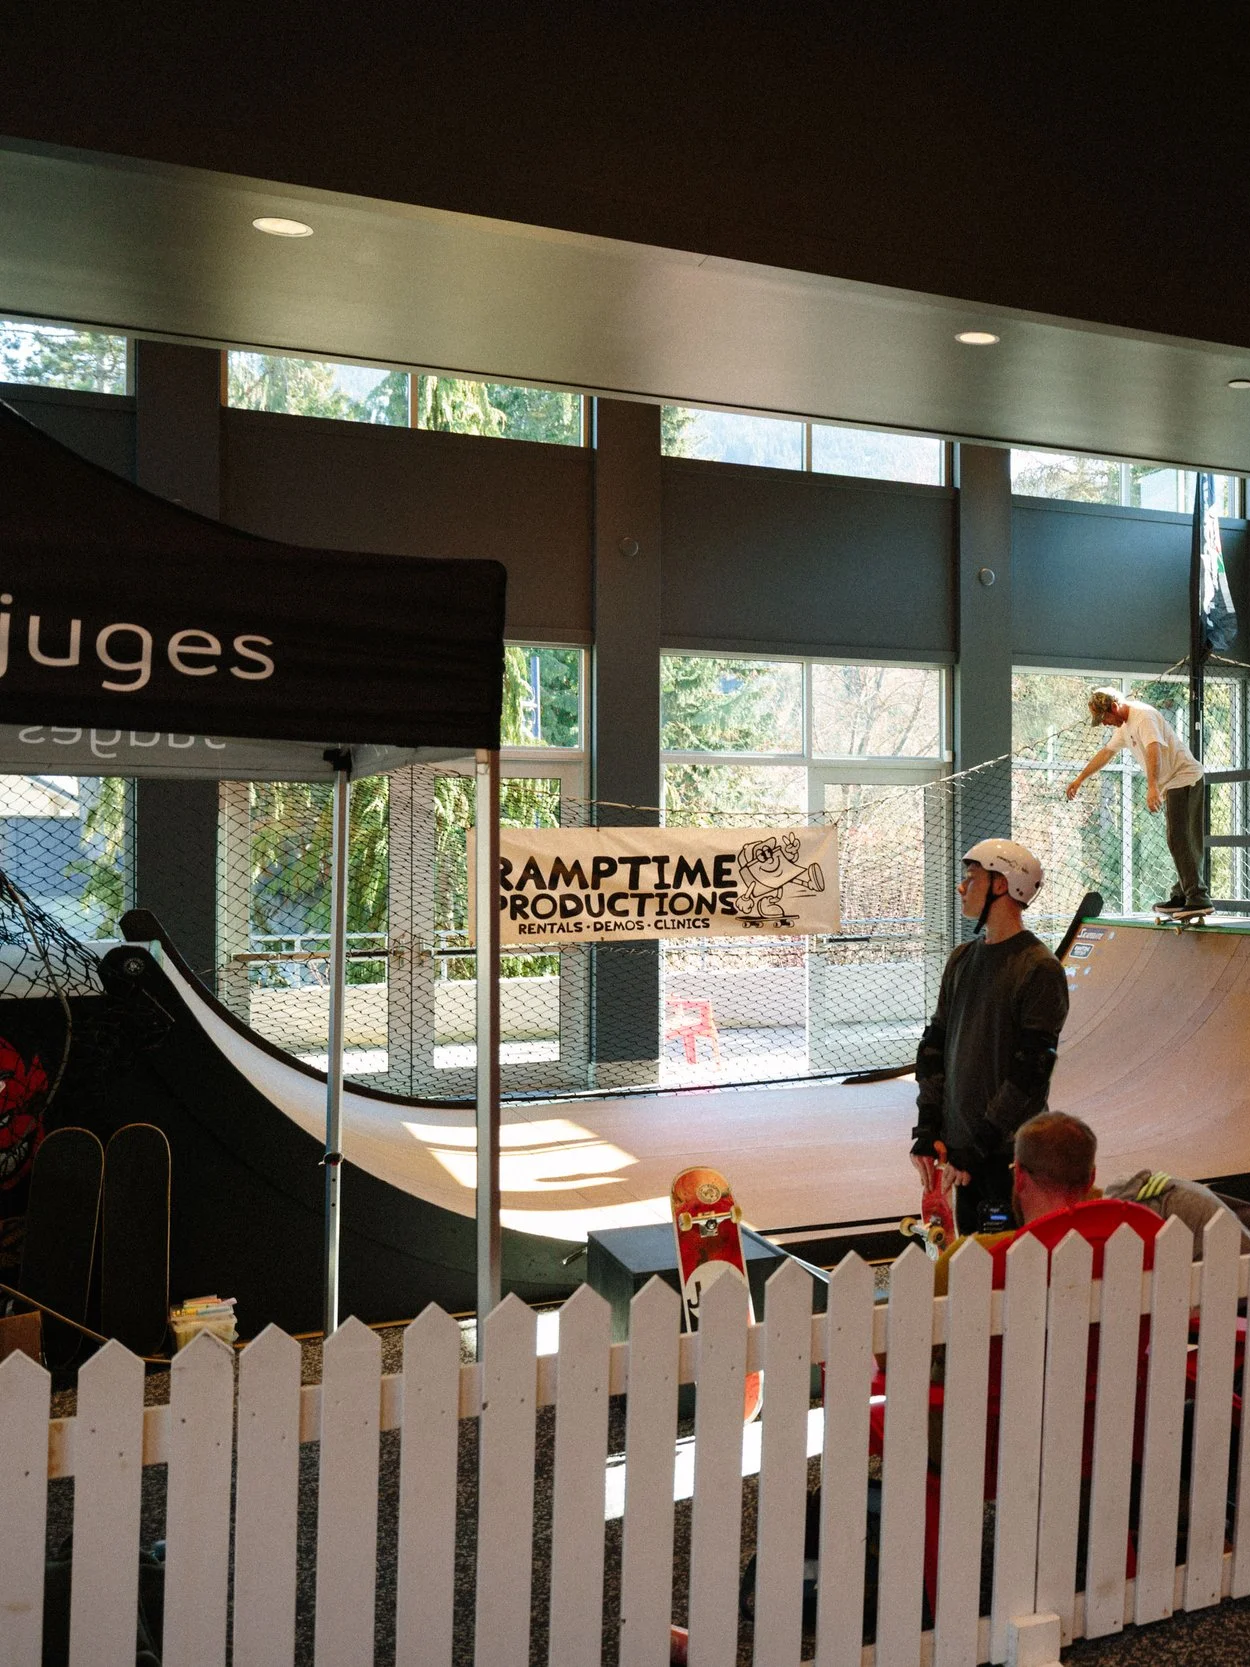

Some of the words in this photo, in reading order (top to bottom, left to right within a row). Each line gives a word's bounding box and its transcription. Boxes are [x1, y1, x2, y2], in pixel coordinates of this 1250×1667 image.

[499, 854, 738, 892] RAMPTIME
[518, 921, 583, 935] RENTALS
[593, 921, 645, 933] DEMOS
[654, 918, 710, 931] CLINICS
